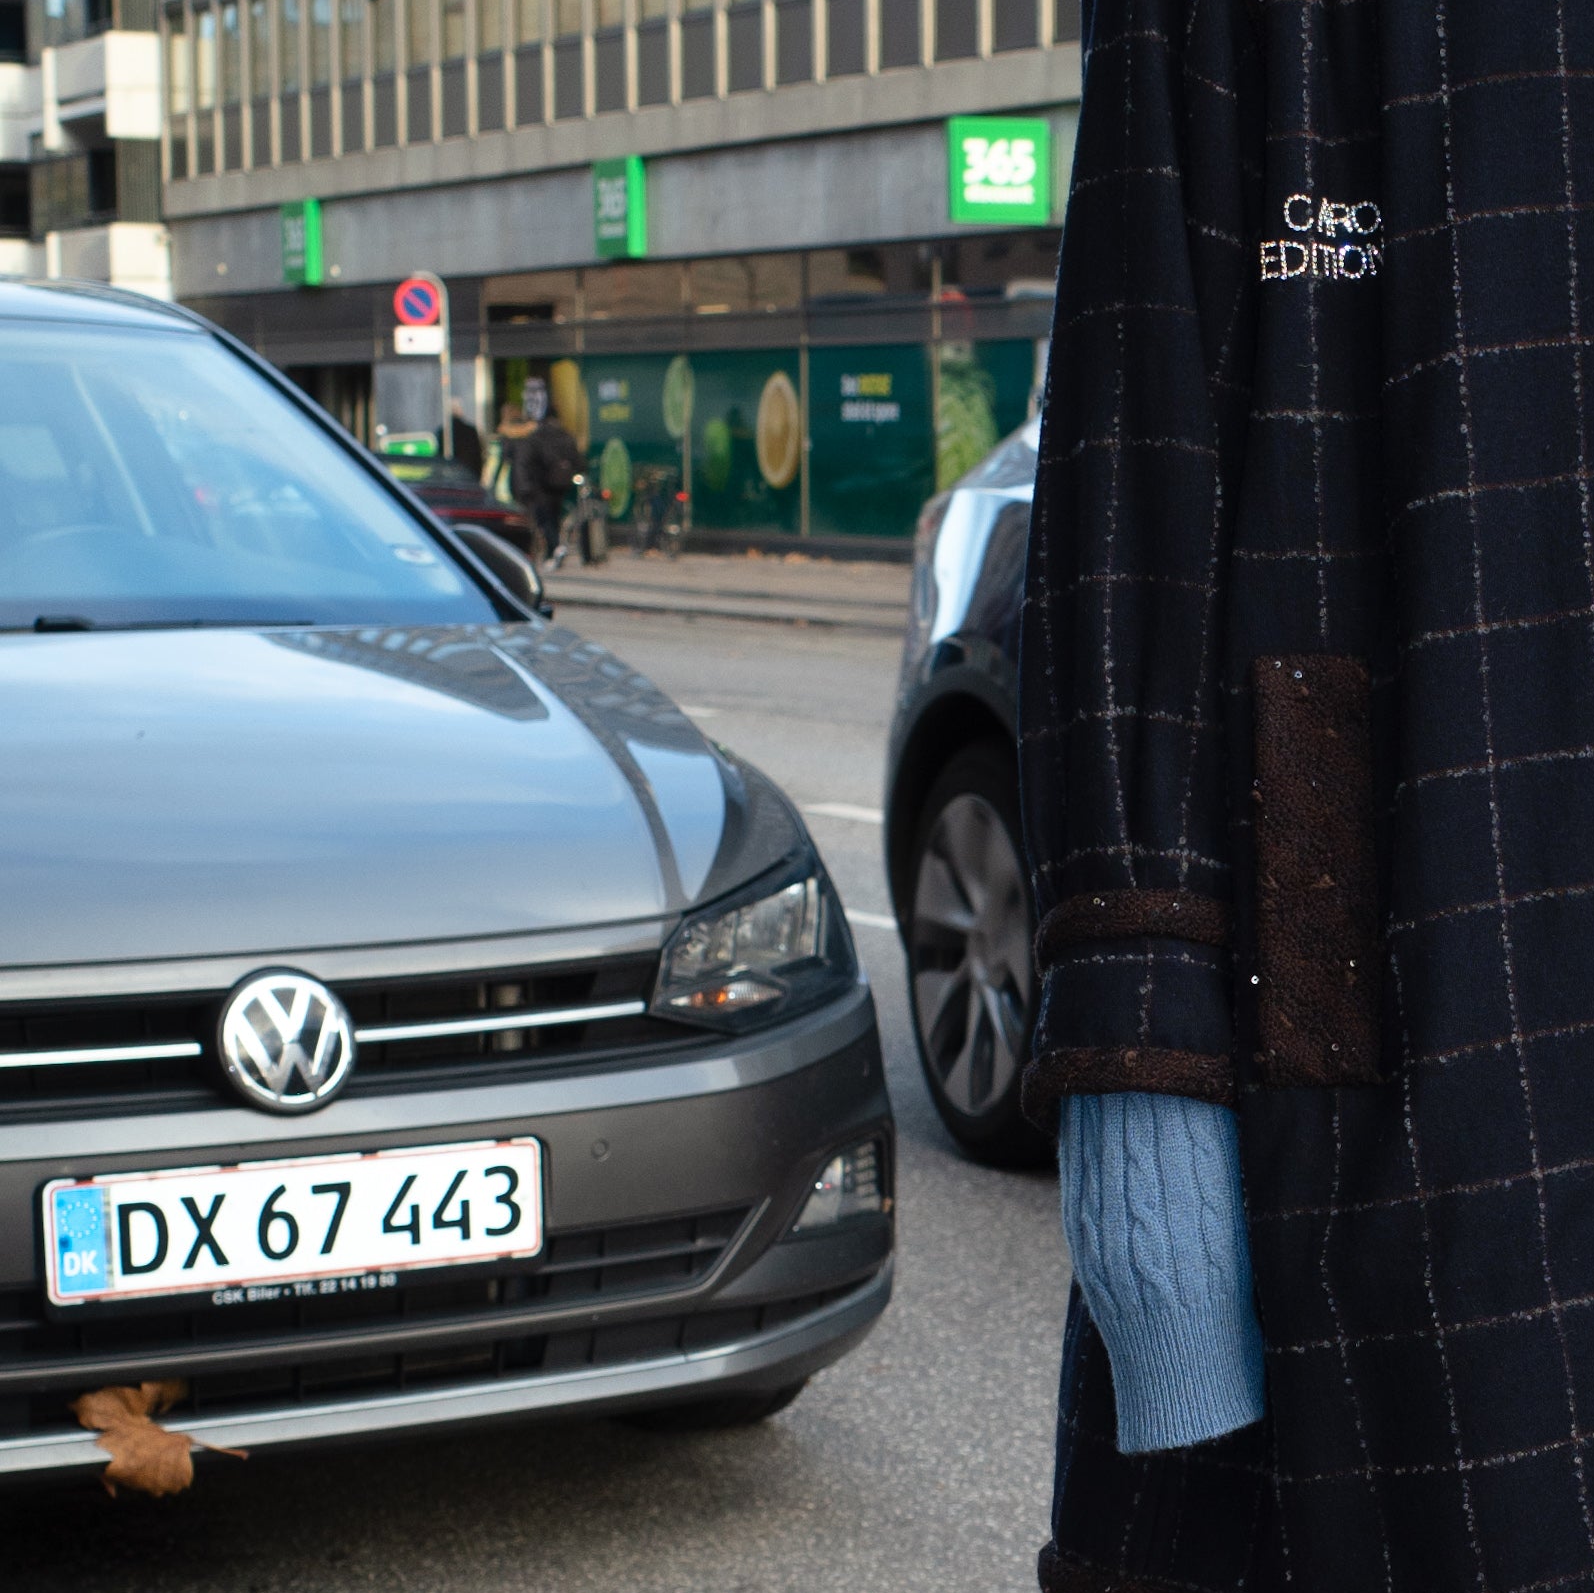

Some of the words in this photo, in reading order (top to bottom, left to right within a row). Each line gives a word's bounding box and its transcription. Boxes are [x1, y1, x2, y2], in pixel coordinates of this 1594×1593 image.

[962, 137, 1037, 186] 365
[117, 1193, 229, 1276] DX
[257, 1181, 351, 1261] 67
[382, 1165, 521, 1245] 443
[63, 1250, 98, 1277] DK
[247, 1286, 281, 1302] Biler
